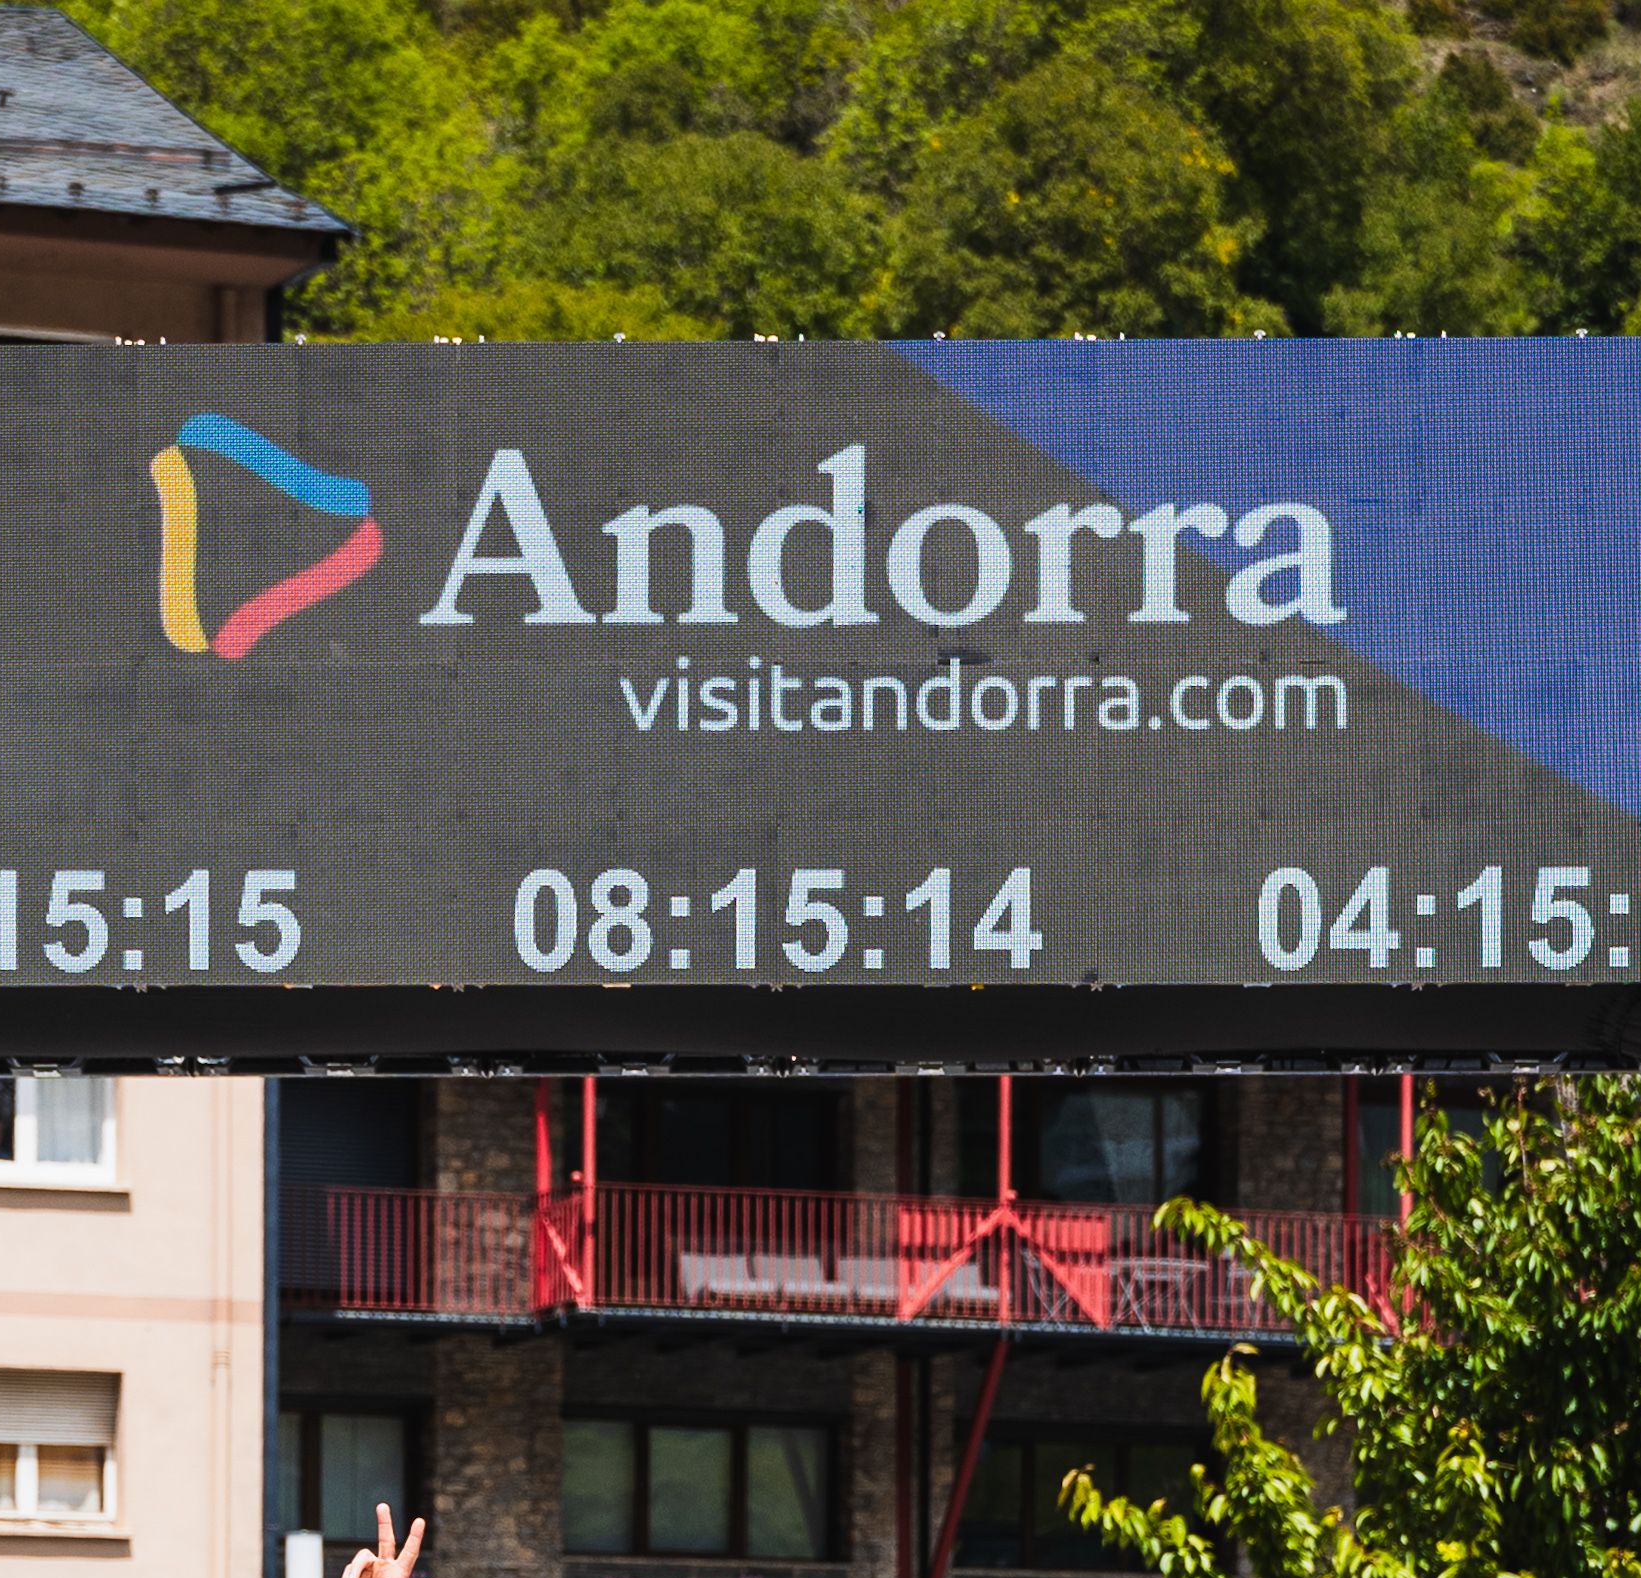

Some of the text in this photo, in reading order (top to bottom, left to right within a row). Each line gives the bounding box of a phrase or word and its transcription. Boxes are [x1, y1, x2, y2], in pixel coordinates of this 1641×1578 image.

[419, 443, 1347, 628] Andorra
[620, 659, 1348, 732] visitandorra.com
[514, 868, 1043, 972] 08:15:14
